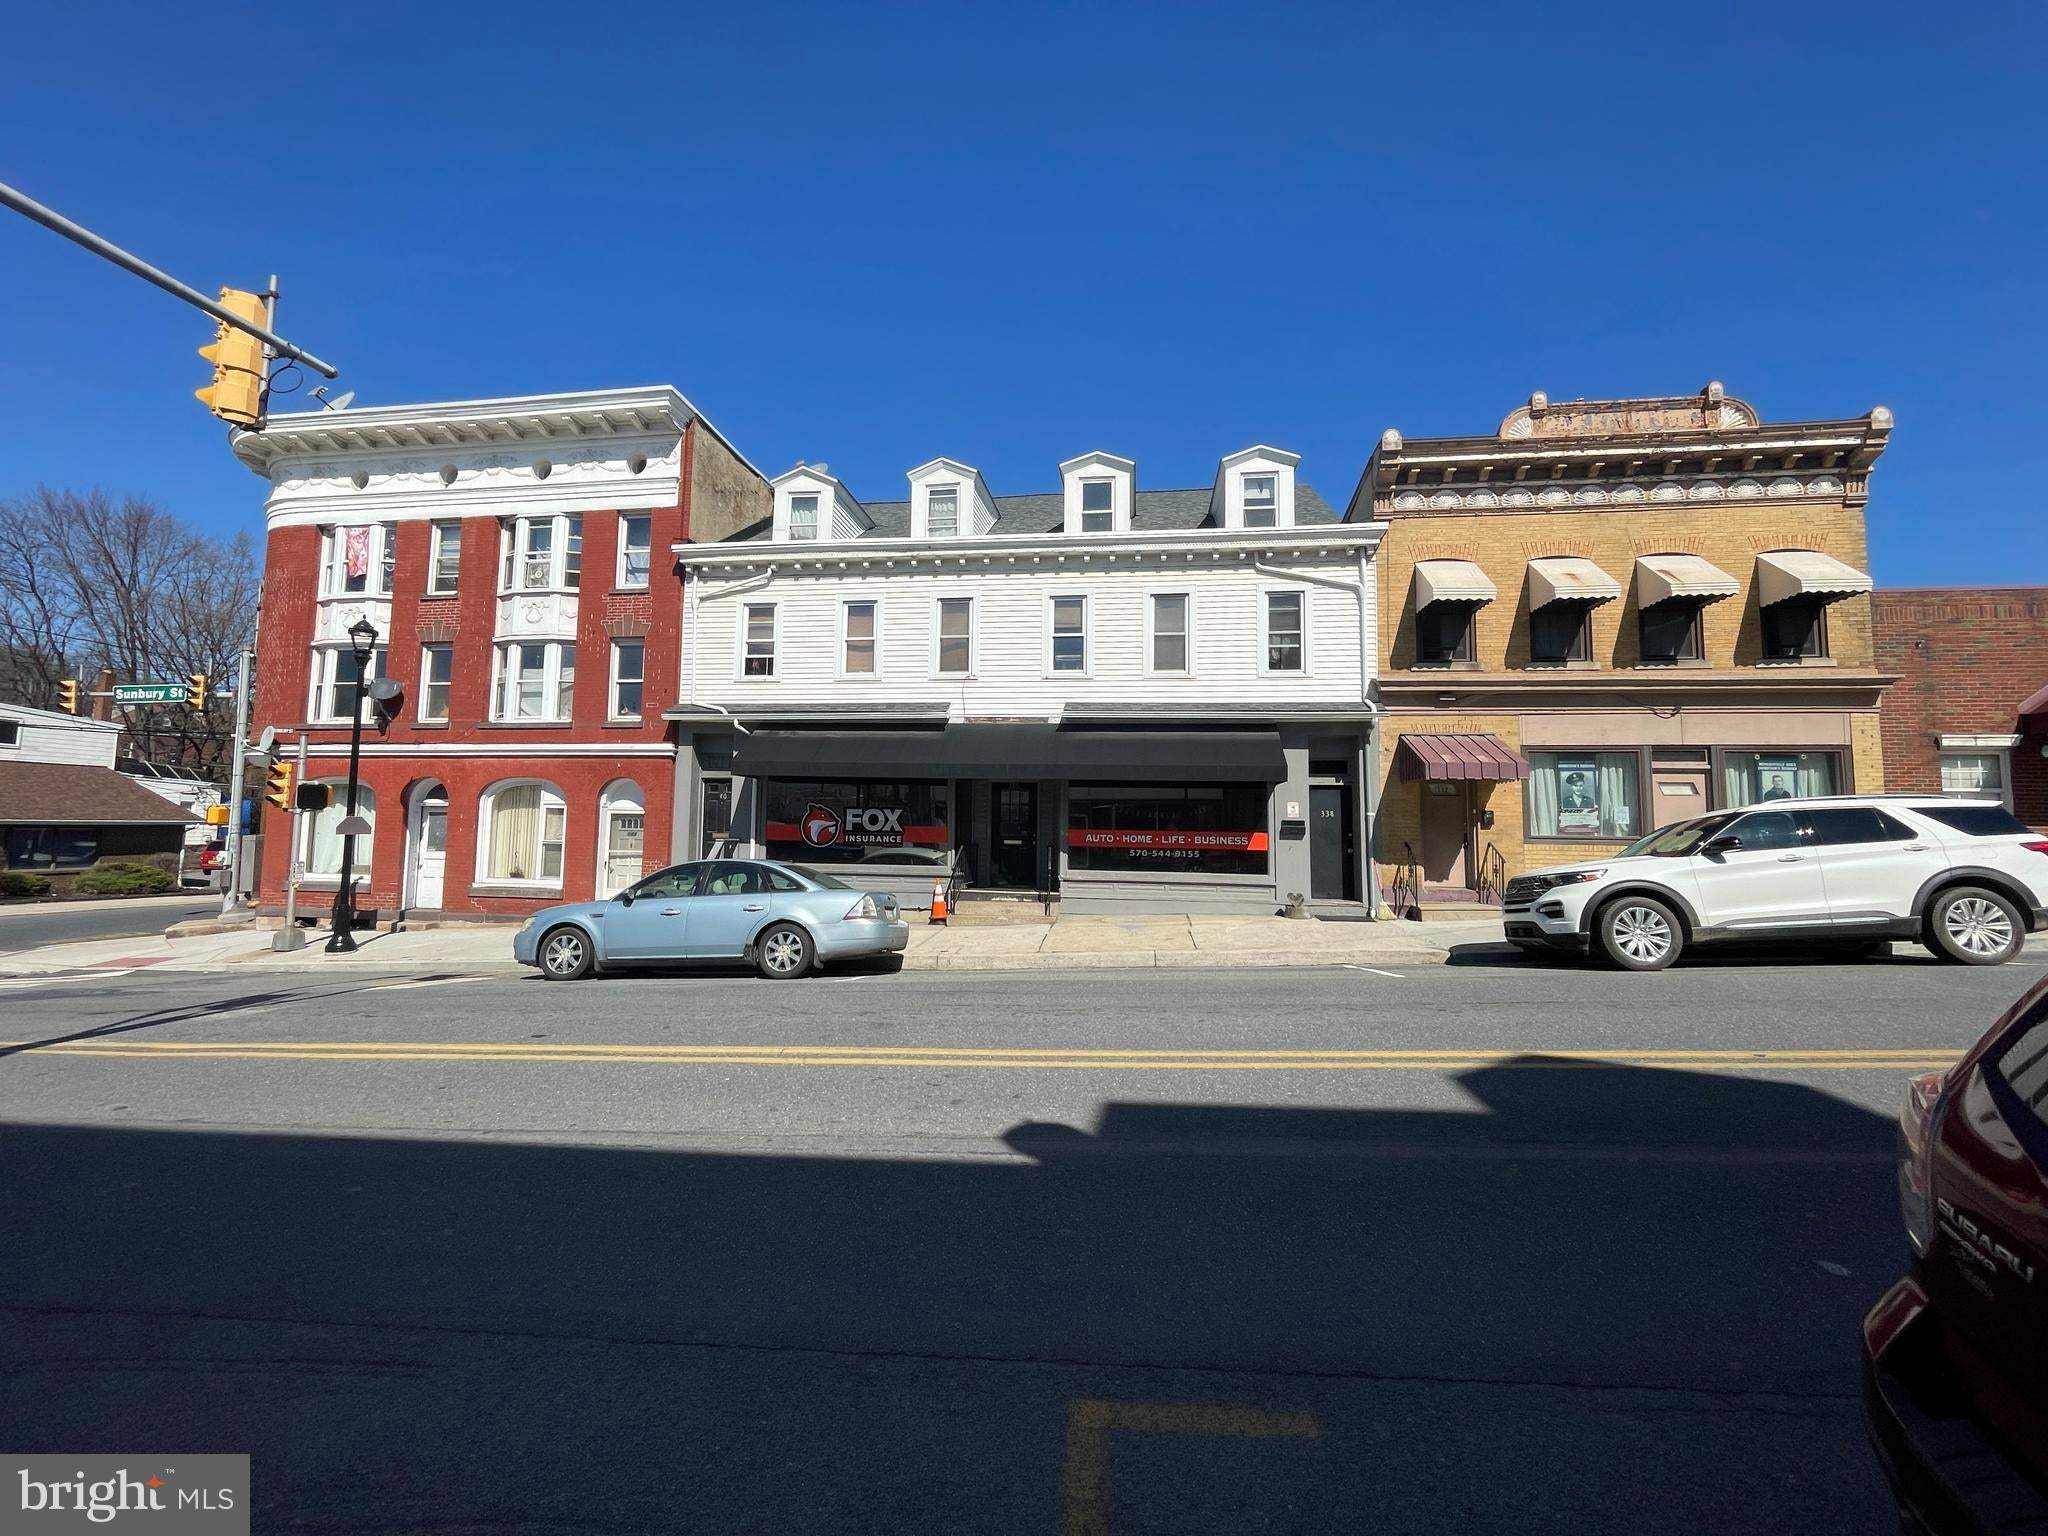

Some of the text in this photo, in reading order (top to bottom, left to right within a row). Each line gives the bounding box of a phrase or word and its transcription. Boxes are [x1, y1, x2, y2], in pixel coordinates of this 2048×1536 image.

[115, 687, 184, 700] Sunbury St
[846, 808, 903, 832] FOX
[1320, 810, 1335, 818] 338
[845, 834, 903, 843] INSURANCE
[1085, 834, 1249, 846] AUTO HOME LIFE BUSINESS
[1129, 849, 1200, 858] 570-544-9155
[1937, 1197, 2035, 1284] SUBARU
